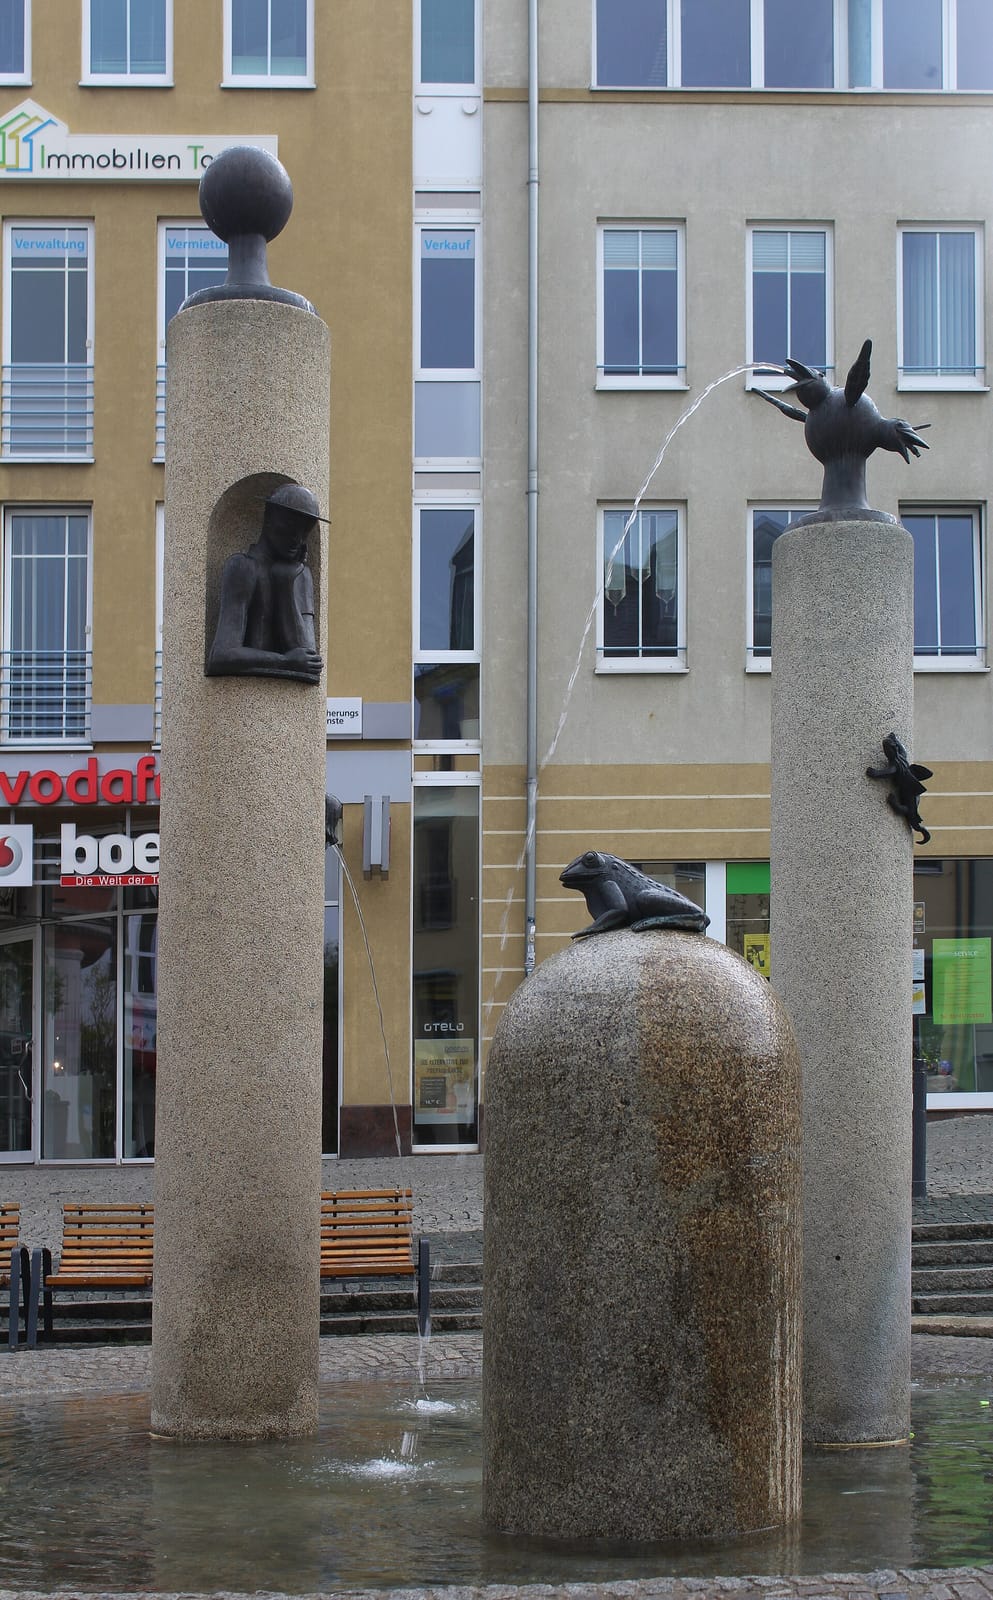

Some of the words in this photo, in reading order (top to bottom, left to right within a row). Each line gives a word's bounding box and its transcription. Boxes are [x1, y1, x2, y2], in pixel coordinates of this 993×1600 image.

[40, 145, 181, 170] Immobilien
[15, 238, 85, 252] Verwaltung
[424, 239, 471, 250] Verkauf
[0, 756, 160, 804] vodaf
[76, 876, 93, 885] Die
[99, 876, 122, 885] Welt
[128, 876, 145, 885] der
